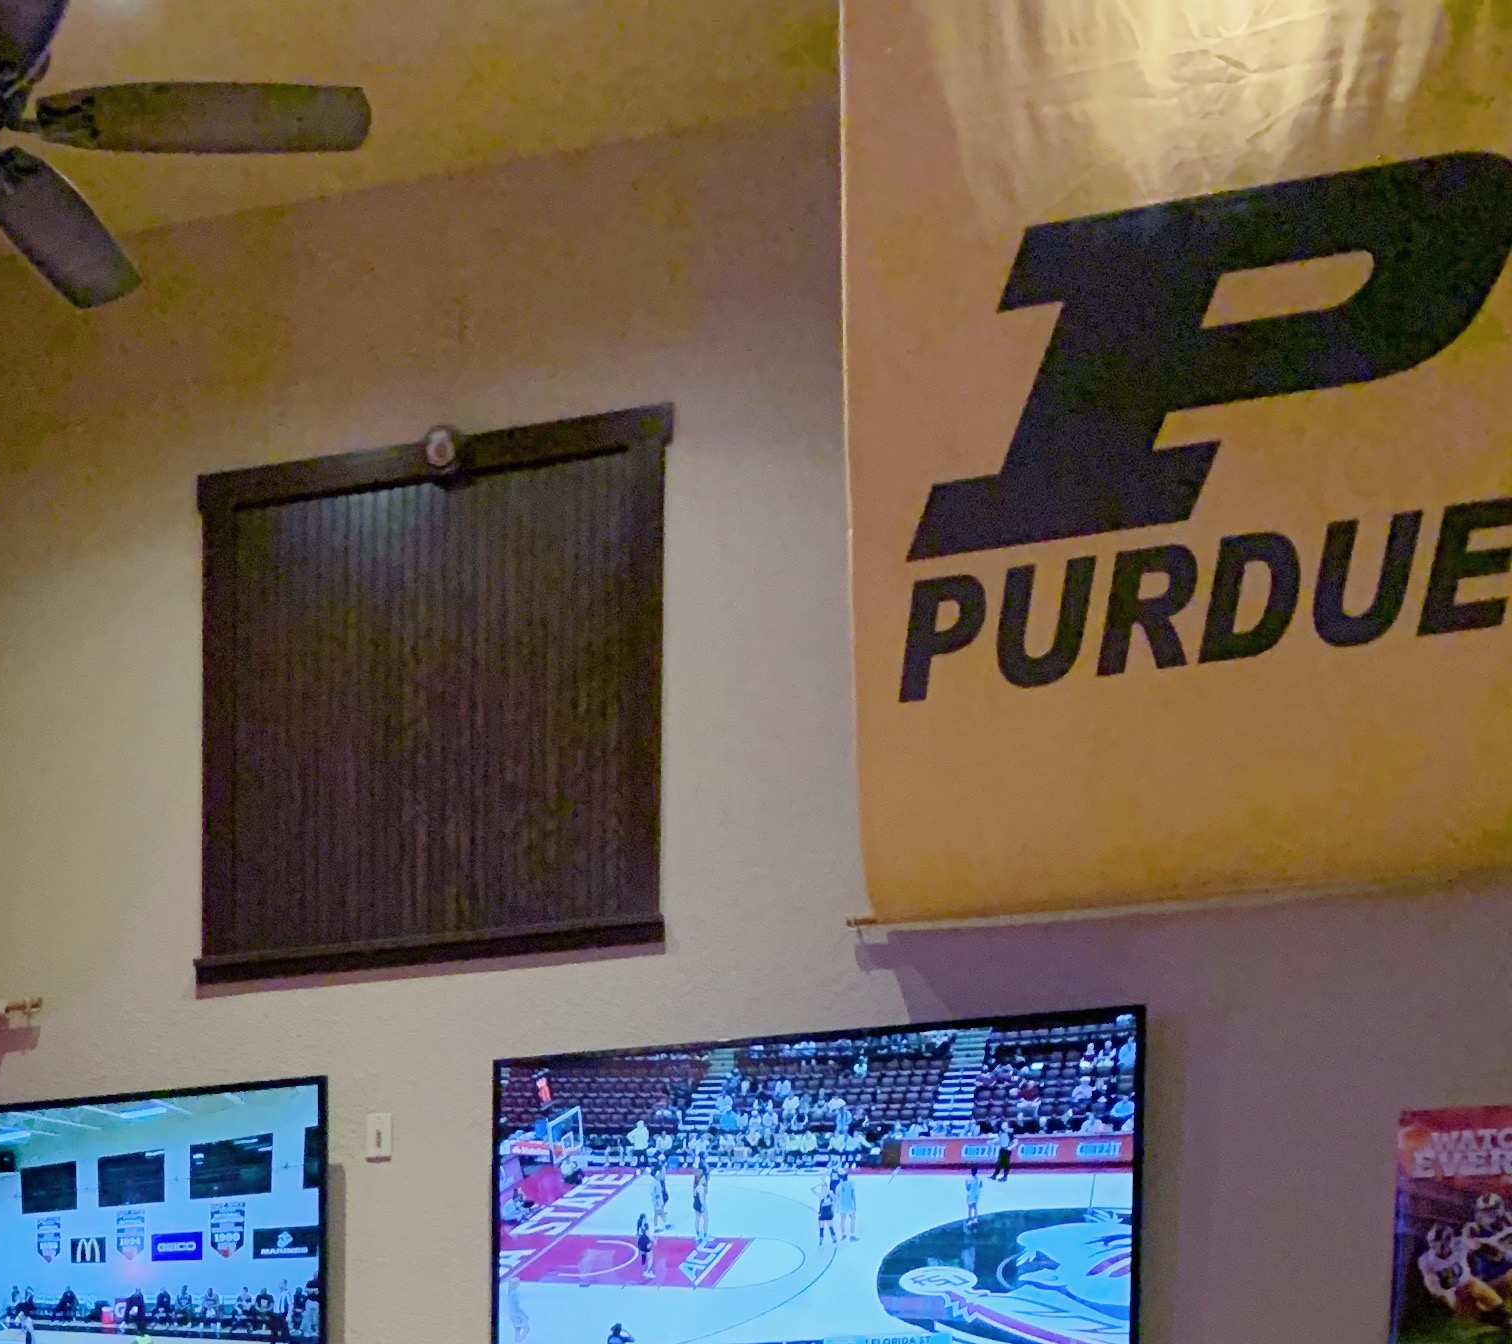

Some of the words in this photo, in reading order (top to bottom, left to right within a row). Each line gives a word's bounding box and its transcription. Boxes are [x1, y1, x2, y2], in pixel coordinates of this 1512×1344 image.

[898, 497, 1512, 703] PURDUE
[510, 1173, 635, 1236] STATE
[156, 1241, 197, 1253] GEICO
[260, 1246, 308, 1256] MARINES
